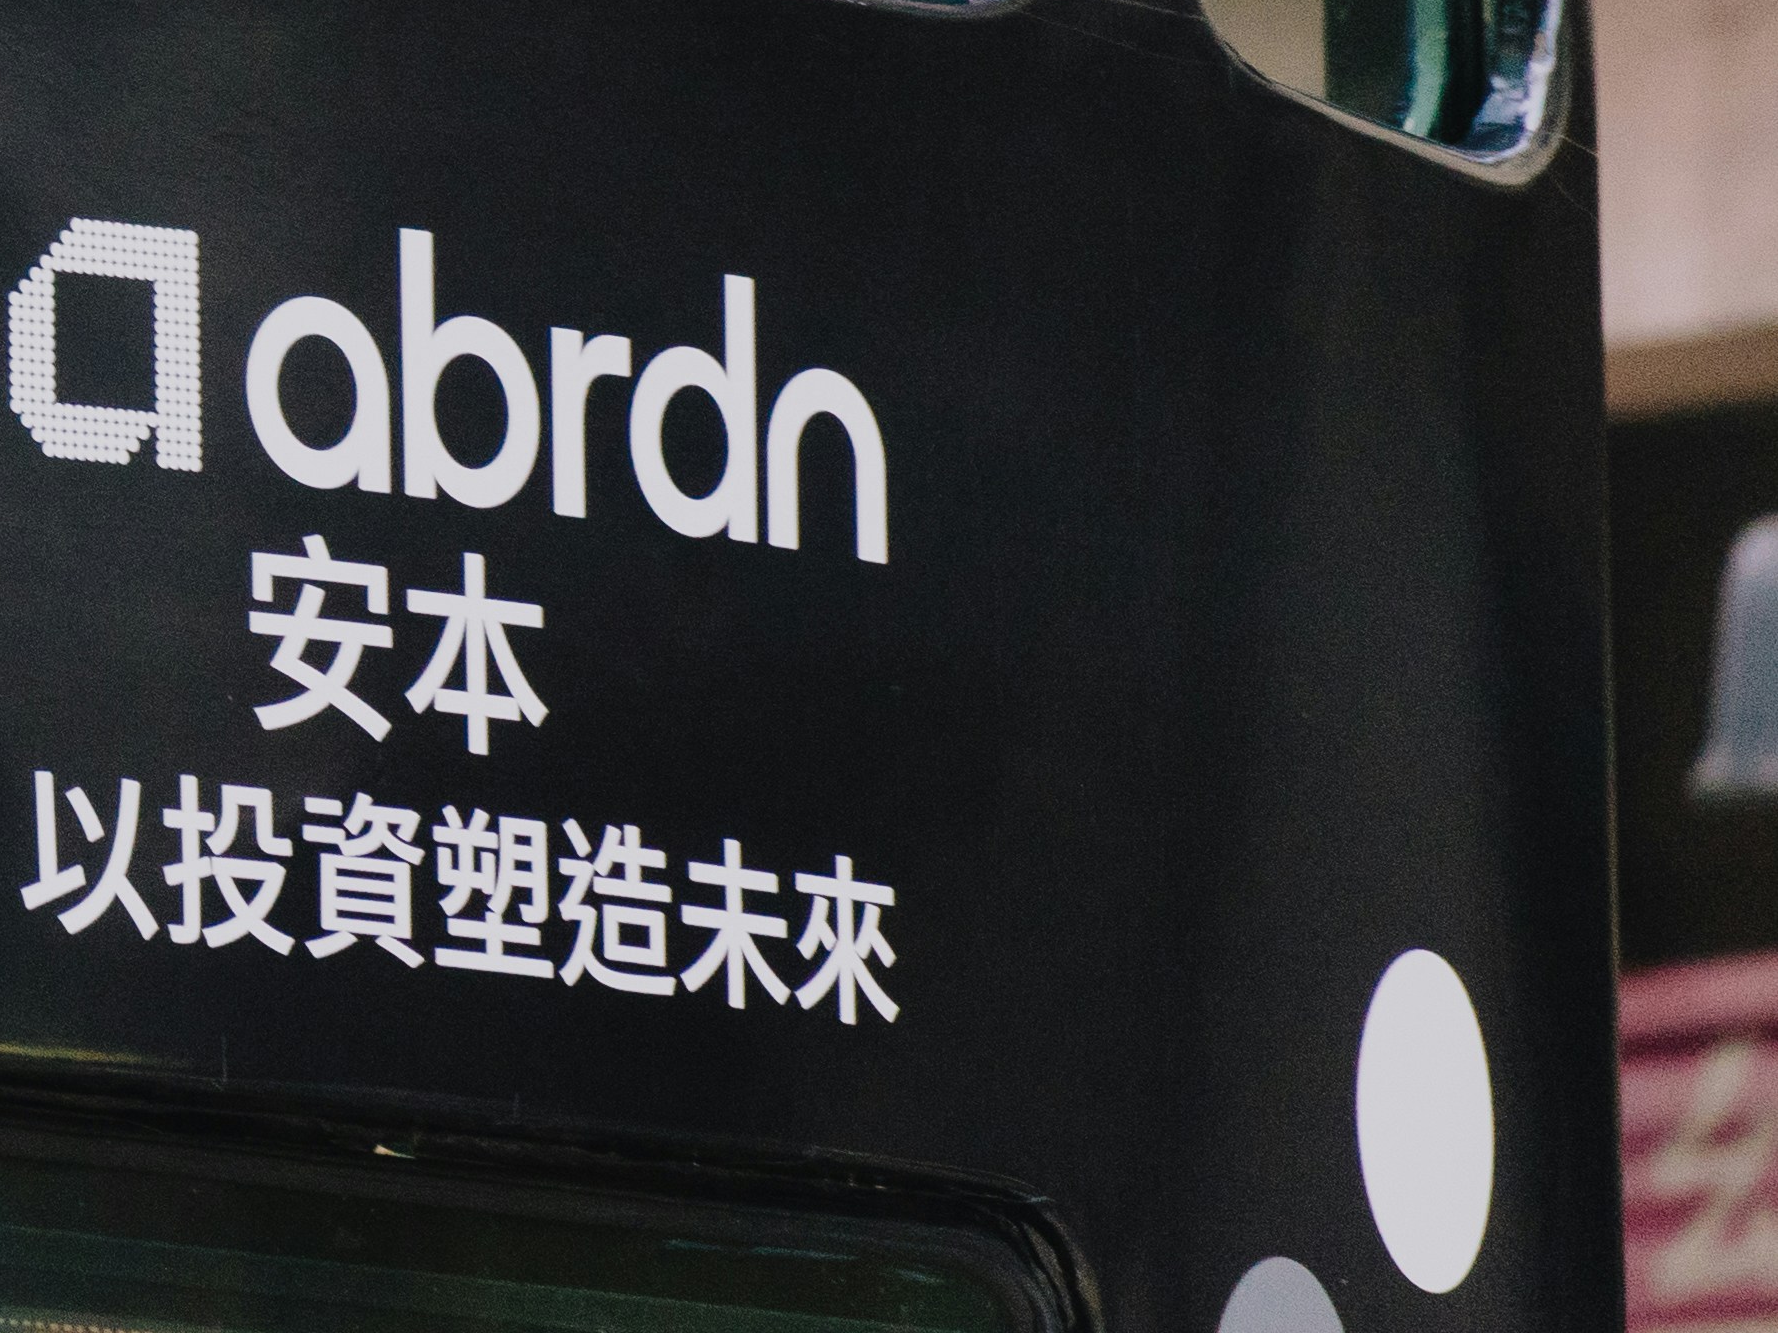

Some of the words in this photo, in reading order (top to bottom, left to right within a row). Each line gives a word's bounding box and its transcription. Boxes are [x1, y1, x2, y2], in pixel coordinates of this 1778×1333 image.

[245, 227, 889, 565] abrdn
[249, 534, 550, 757] 安本
[20, 769, 901, 1026] 以投資塑造未來
